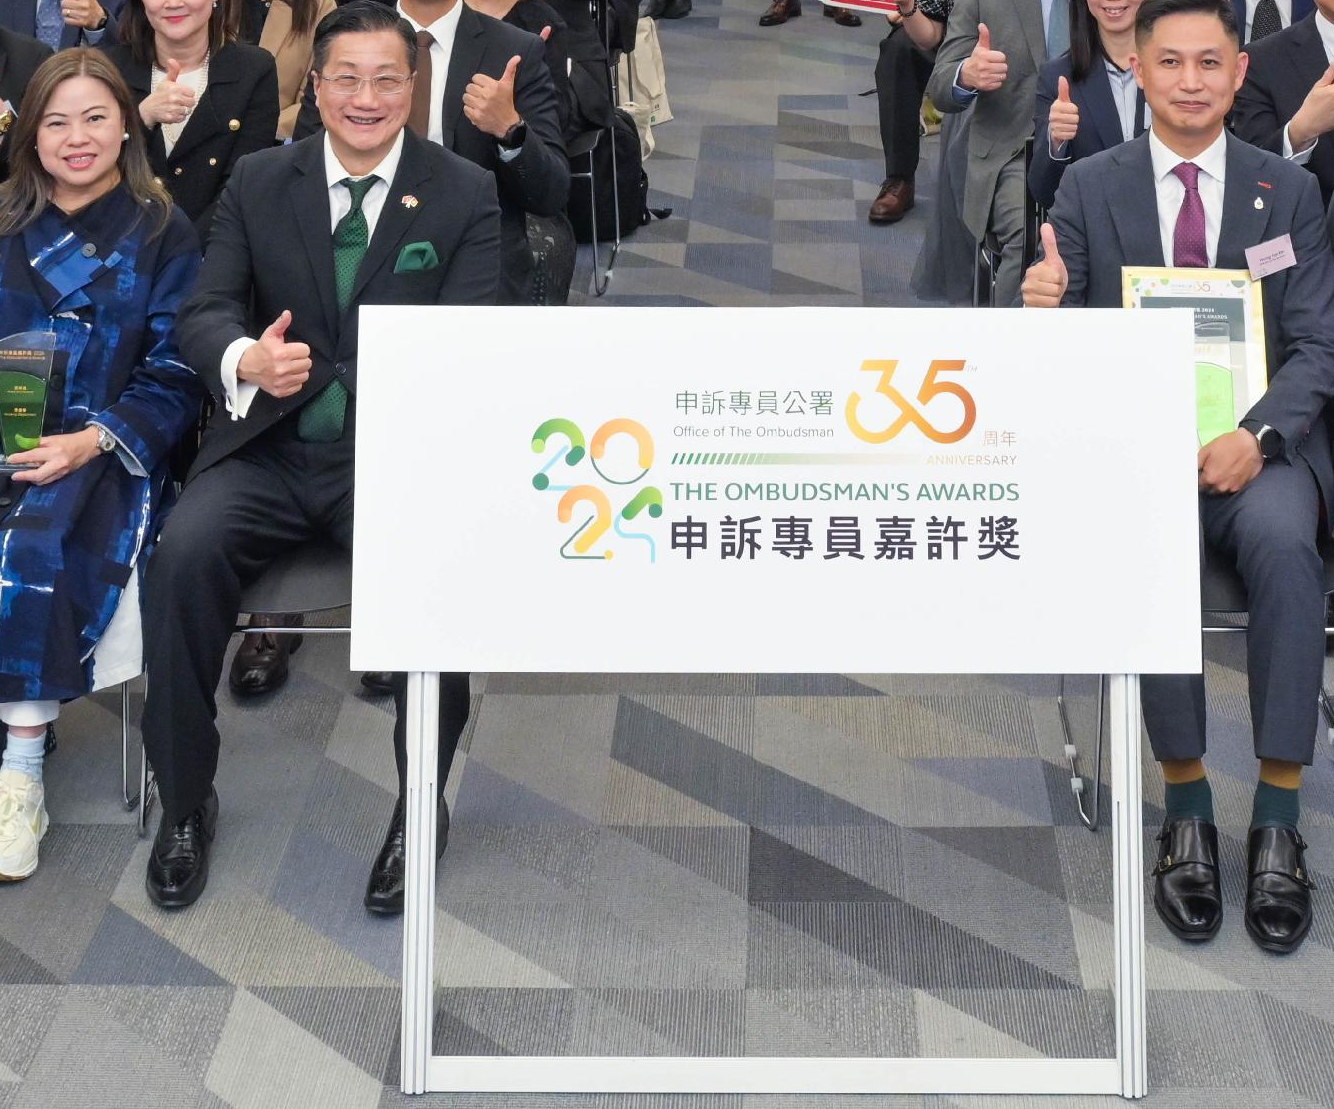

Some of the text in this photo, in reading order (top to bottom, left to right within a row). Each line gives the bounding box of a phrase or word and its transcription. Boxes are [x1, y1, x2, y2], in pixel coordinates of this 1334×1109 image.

[674, 388, 834, 417] 申訴專員公署
[845, 358, 977, 445] 35
[673, 424, 835, 438] Office of The Ombudsman
[982, 430, 1018, 447] 周年
[926, 454, 1018, 466] ANNIVERSARY
[669, 481, 1020, 502] THE OMBUDSMAN'S AWARDS
[670, 514, 1022, 562] 申訴專員嘉許獎
